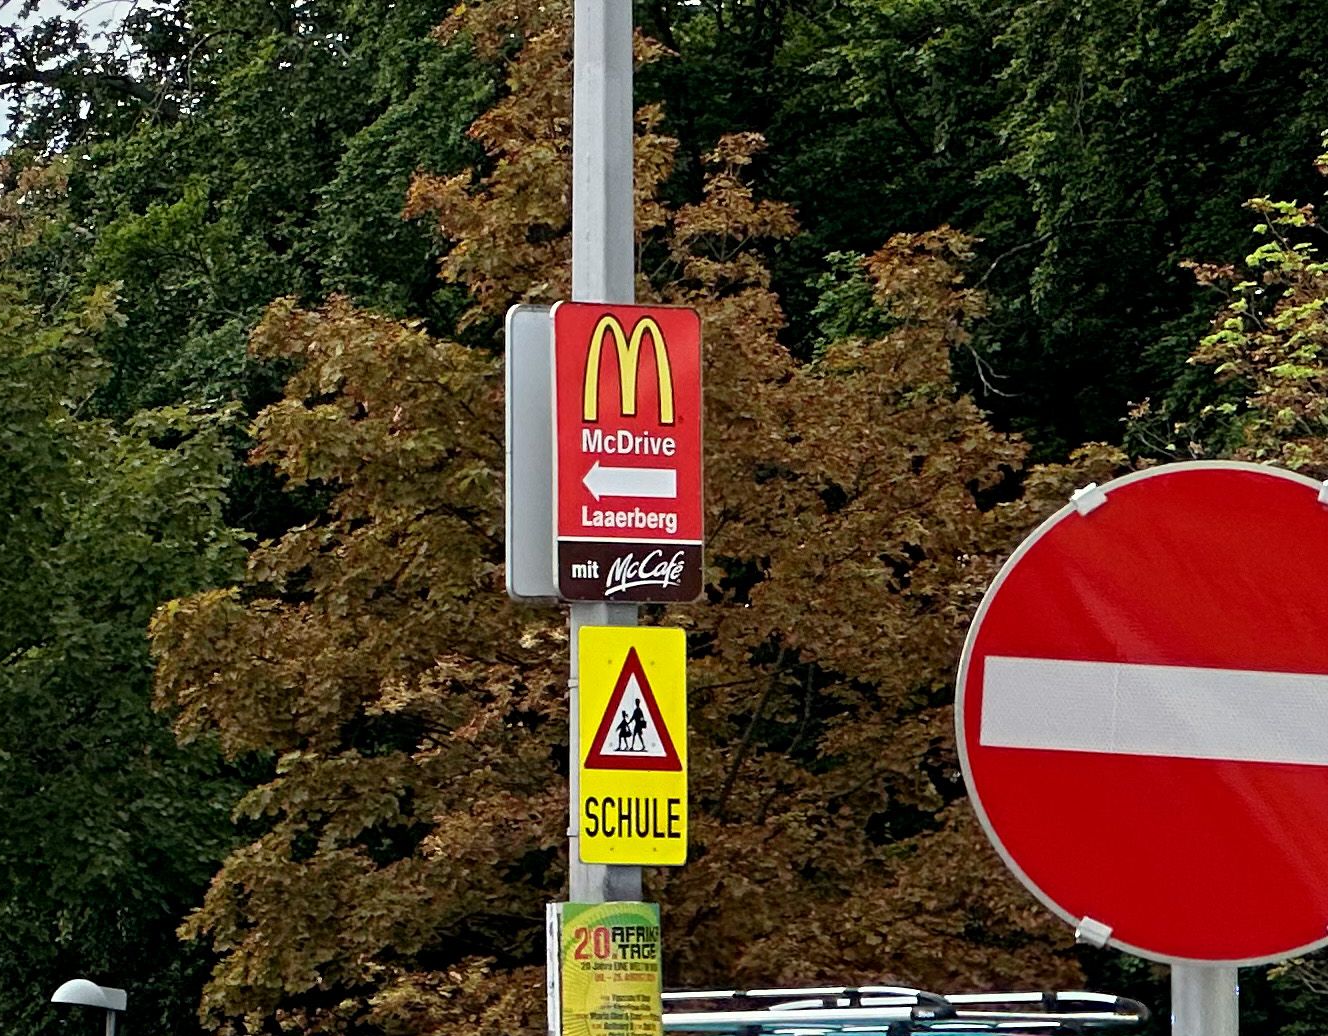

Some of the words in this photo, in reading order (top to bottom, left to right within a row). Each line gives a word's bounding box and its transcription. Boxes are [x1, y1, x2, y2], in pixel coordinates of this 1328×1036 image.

[582, 428, 676, 456] McDrive
[581, 505, 677, 534] Laaerberg
[572, 560, 599, 579] mit
[605, 549, 685, 592] McCafé
[585, 797, 681, 838] SCHULE
